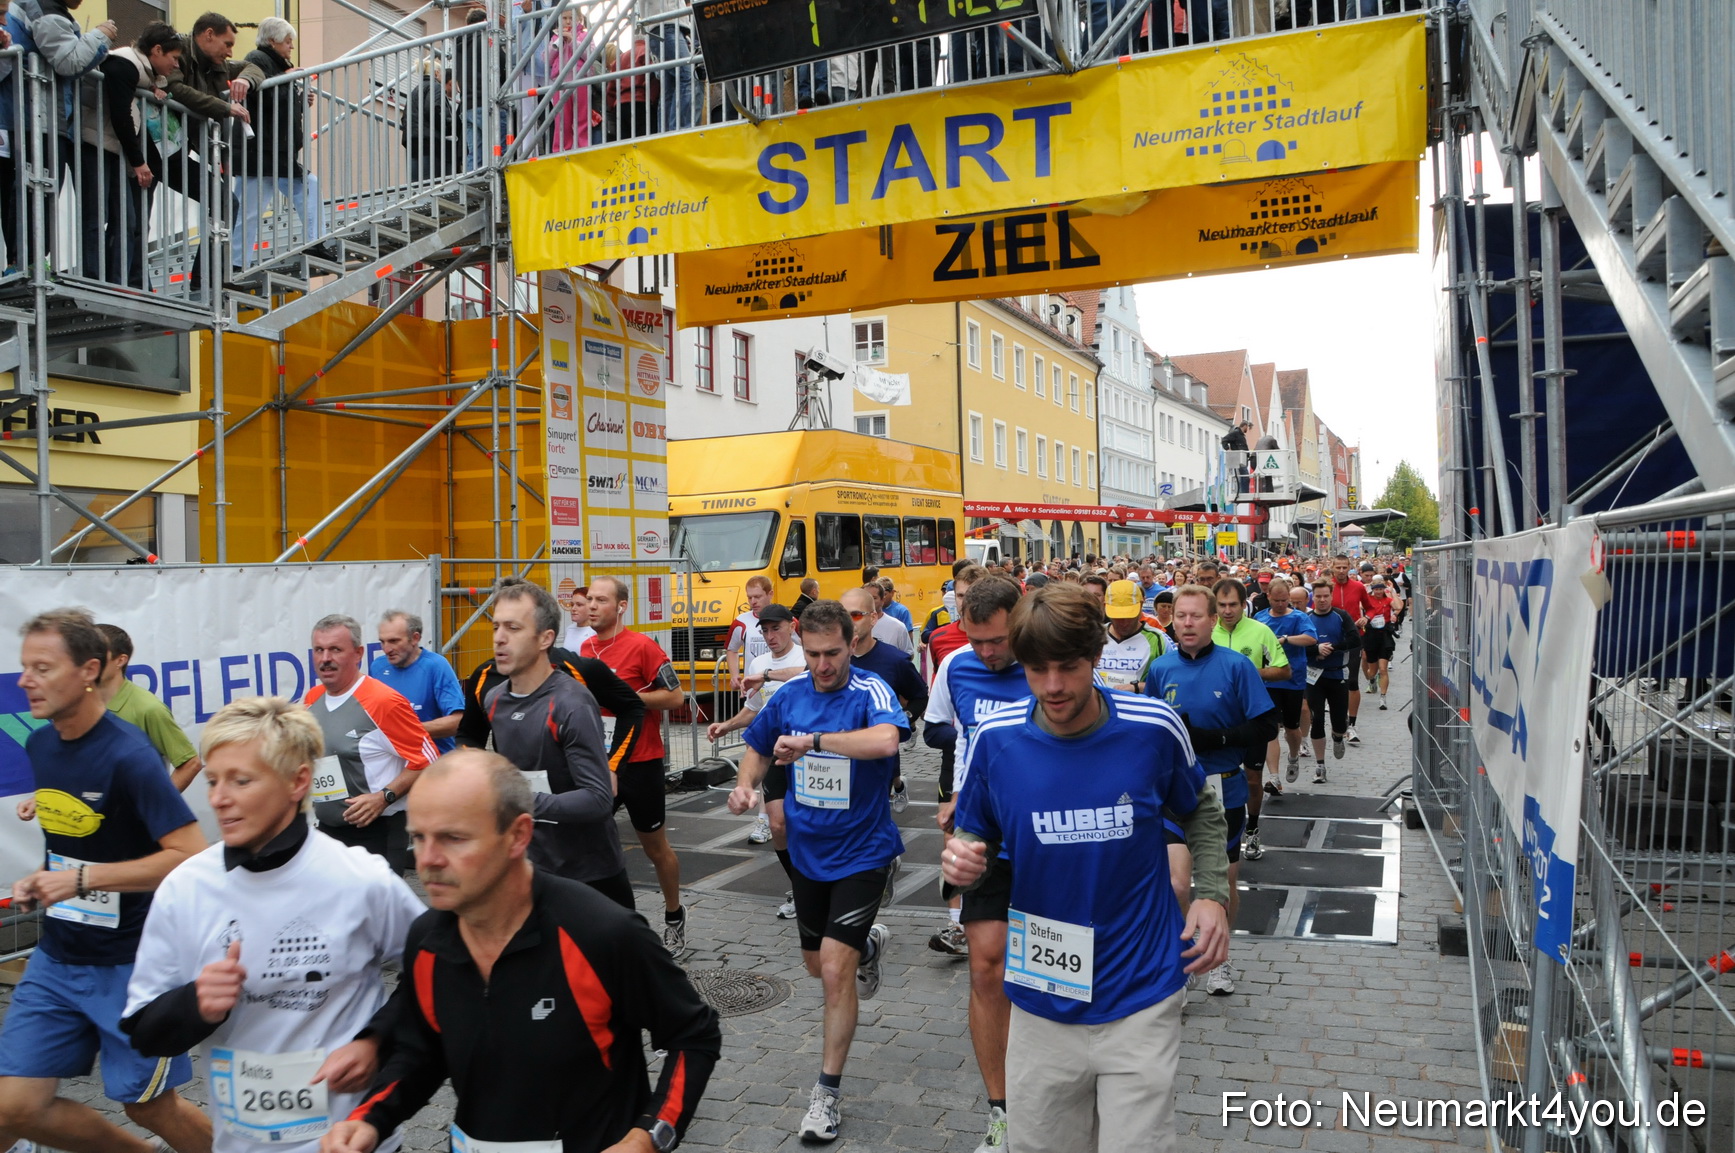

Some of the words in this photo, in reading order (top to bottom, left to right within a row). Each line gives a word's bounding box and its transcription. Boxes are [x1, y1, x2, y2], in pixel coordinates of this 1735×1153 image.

[1133, 117, 1256, 149] Neumarkter
[1262, 100, 1364, 132] Stadtlauf
[756, 101, 1072, 215] START
[543, 207, 630, 233] Neumarkter
[633, 196, 709, 219] Stadtlauf
[1198, 219, 1295, 243] Neumarkter
[1300, 207, 1377, 234] Stadtlauf
[933, 209, 1101, 282] ZIEL
[704, 276, 782, 297] Neumarkter
[784, 269, 847, 288] Stadtlauf
[622, 308, 663, 327] MERZ
[552, 360, 568, 369] KANN
[587, 411, 625, 434] Charivari
[633, 420, 667, 440] OBI
[547, 427, 577, 442] Sinupret
[548, 442, 566, 455] forte
[557, 465, 579, 475] Egner
[635, 476, 658, 490] MCM
[837, 490, 868, 500] SPORTRONIC
[912, 497, 925, 507] EVENT
[925, 499, 941, 508] SERVICE
[701, 498, 757, 510] TIMING
[1038, 507, 1073, 515] Serviceline:
[551, 547, 582, 555] HACKNER
[672, 616, 719, 624] EQUPMENT
[1107, 675, 1125, 684] Helmut
[808, 761, 831, 773] Walter
[808, 776, 842, 792] 2541
[1031, 804, 1134, 833] HUBER
[1056, 827, 1131, 842] TECHNOLOGY
[1030, 922, 1063, 943] Stefan
[1012, 937, 1018, 947] B
[1031, 944, 1082, 973] 2549
[1056, 983, 1090, 997] PFLEIDERER
[240, 1059, 273, 1080] Anita
[242, 1088, 313, 1112] 2666
